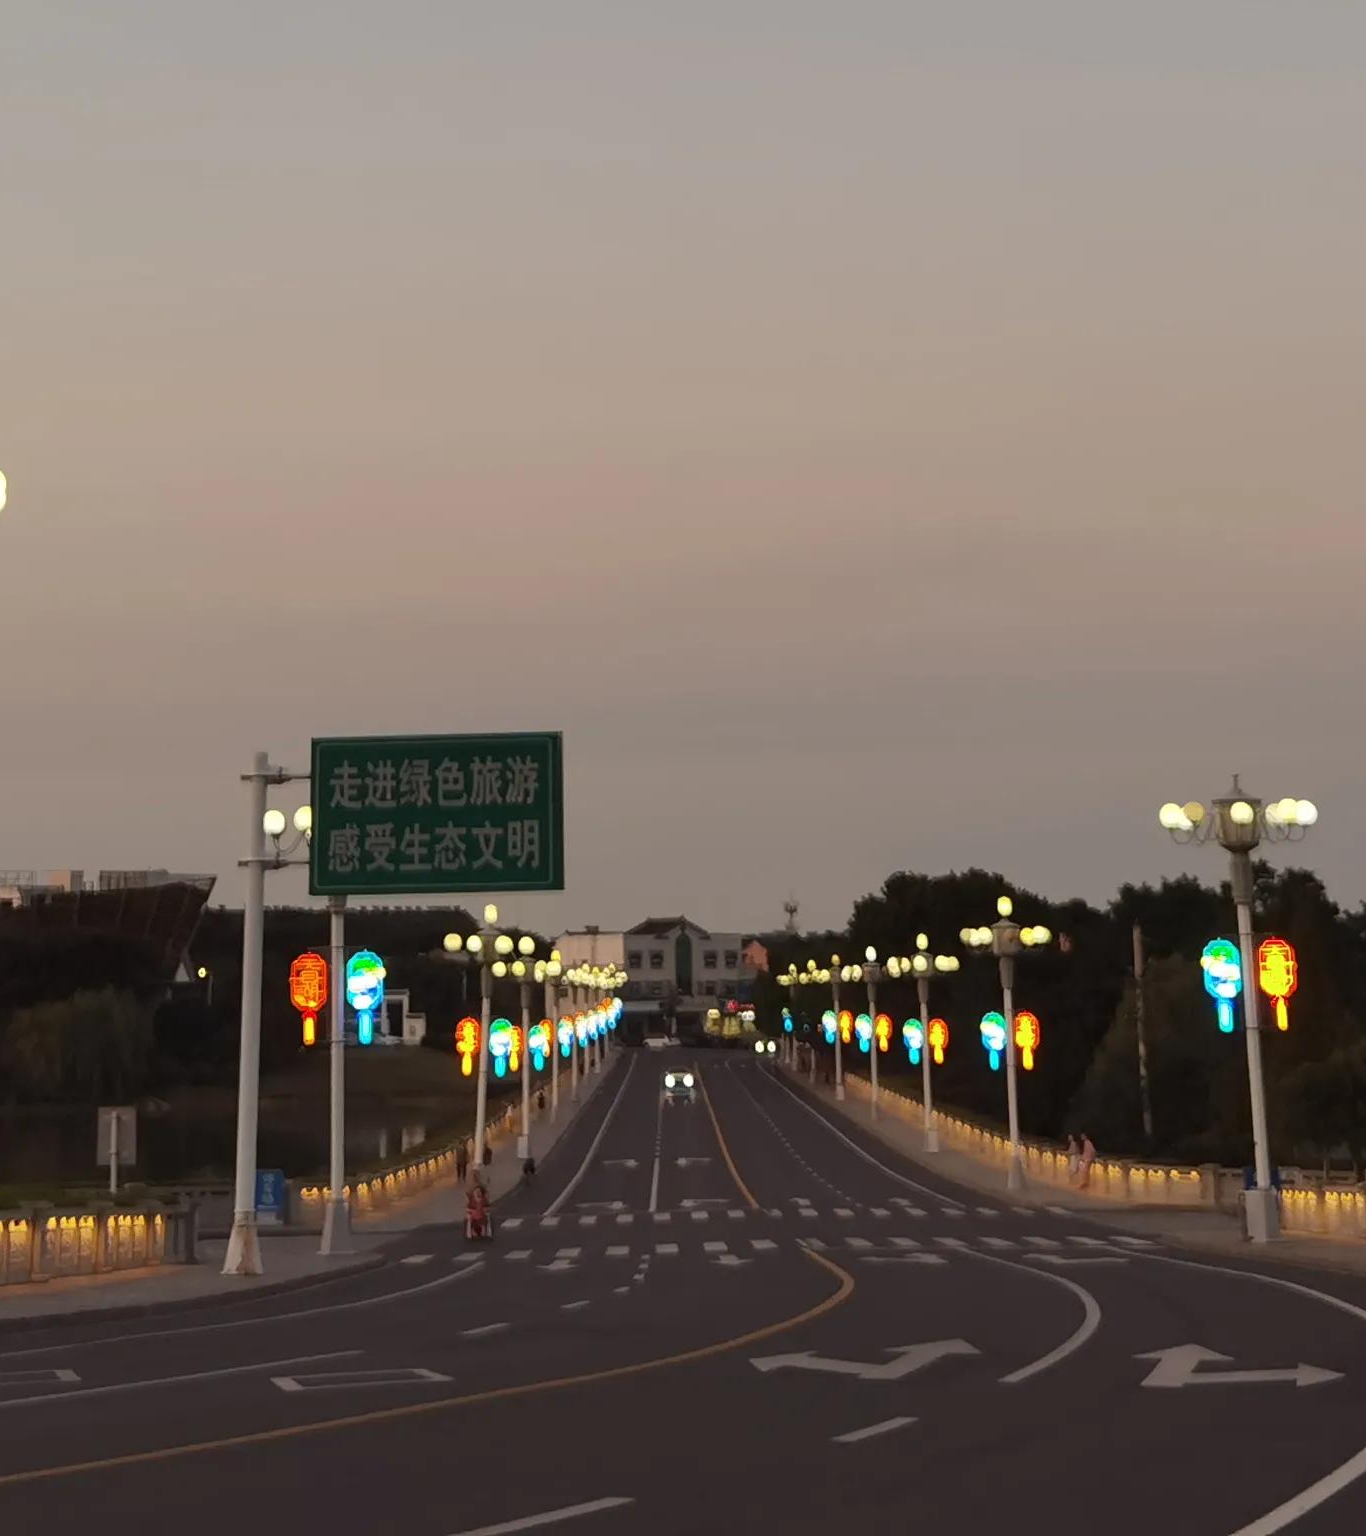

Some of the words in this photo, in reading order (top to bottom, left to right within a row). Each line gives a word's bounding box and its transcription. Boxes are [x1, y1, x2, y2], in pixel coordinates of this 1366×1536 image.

[330, 755, 539, 808] 走进绿色旅游
[329, 819, 540, 872] 感受生态文明
